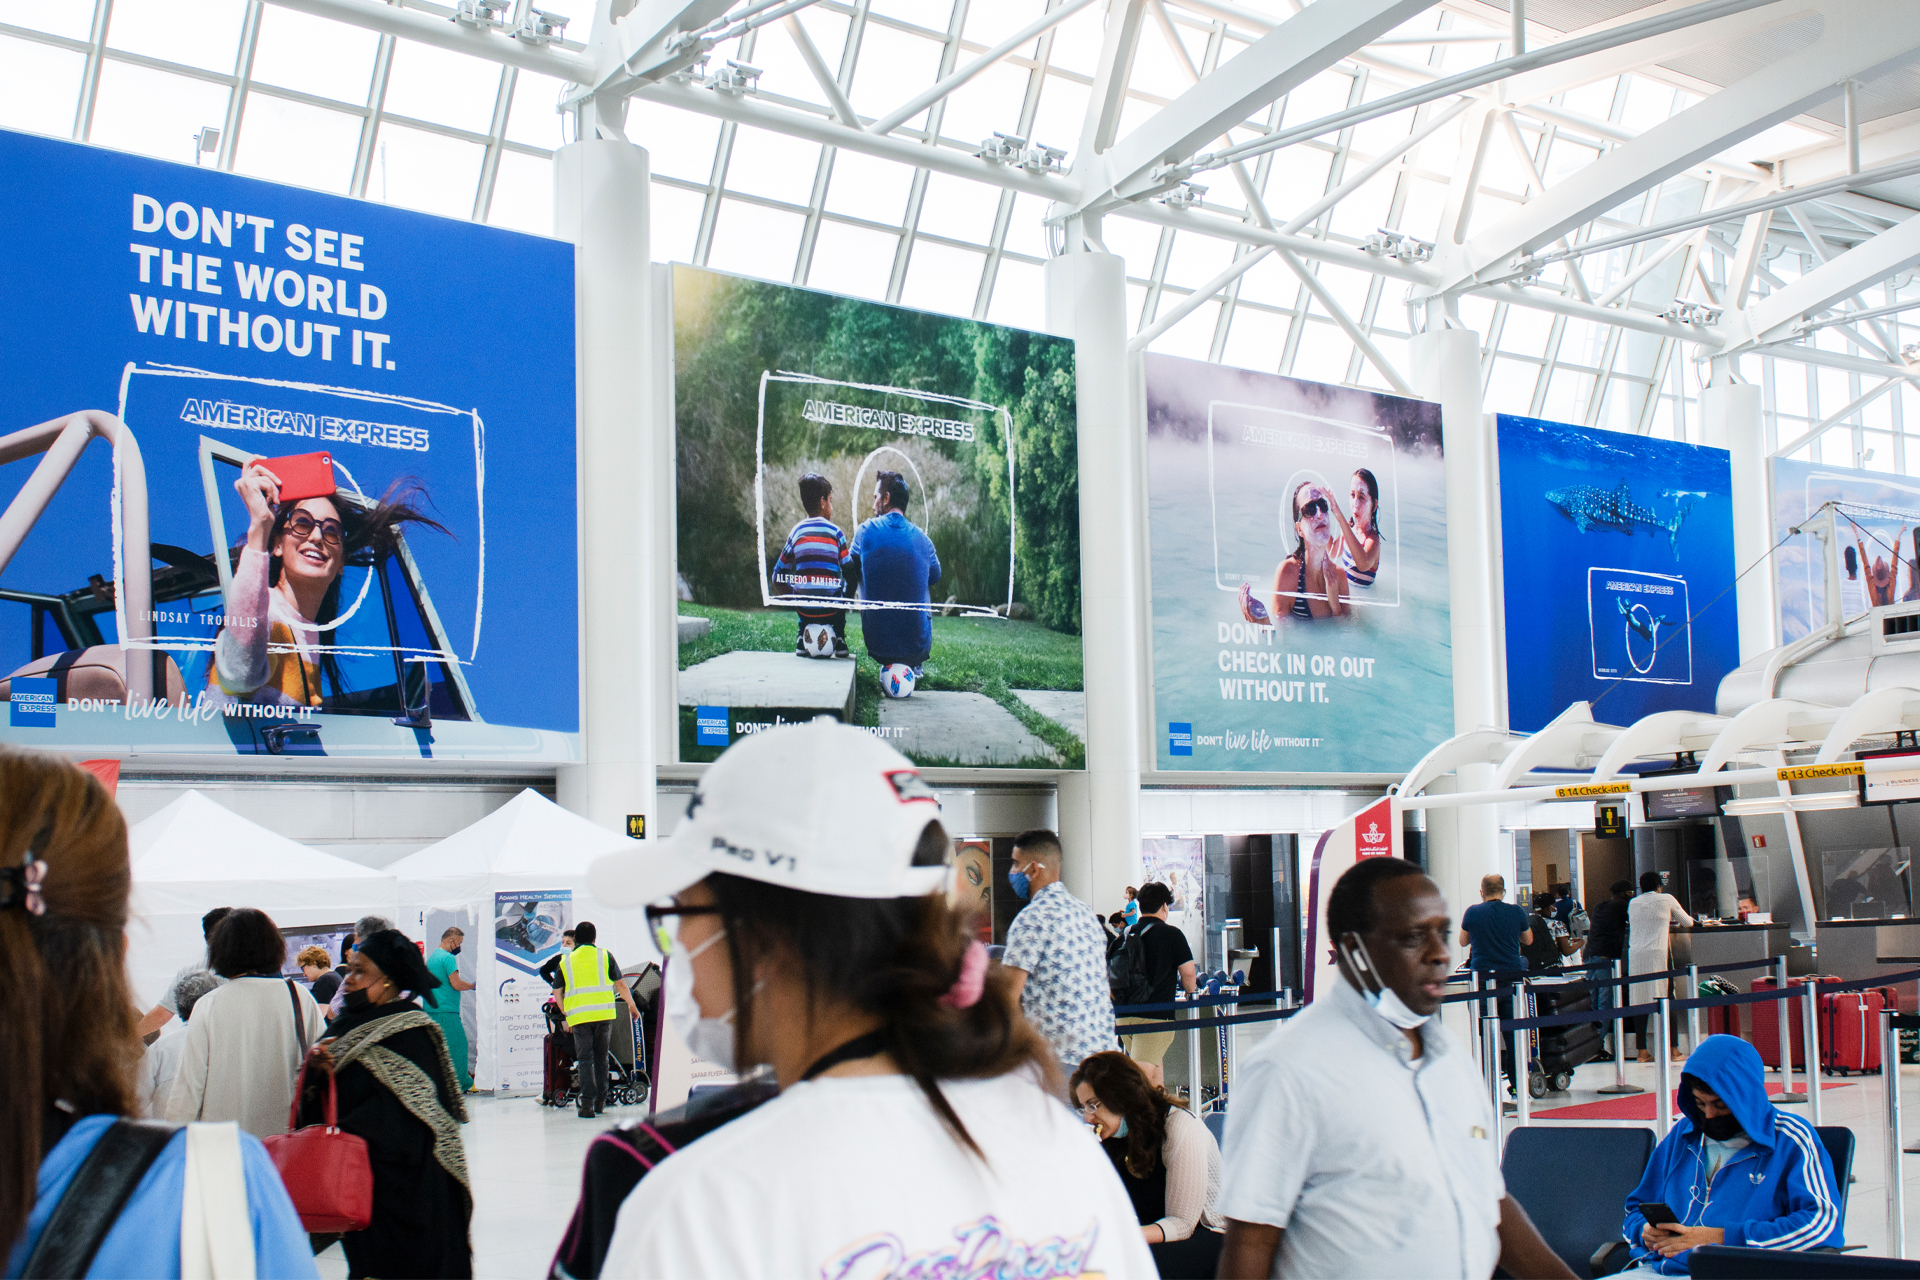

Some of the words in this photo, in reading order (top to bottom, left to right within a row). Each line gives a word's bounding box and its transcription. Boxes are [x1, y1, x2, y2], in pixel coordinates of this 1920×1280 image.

[133, 194, 274, 253] DON’T
[285, 224, 364, 271] SEE
[130, 243, 222, 295] THE
[234, 261, 387, 320] WORLD
[130, 293, 340, 361] WITHOUT
[352, 330, 396, 370] IT.
[180, 398, 316, 438] AMERICAN
[320, 416, 429, 452] EXPRESS
[802, 399, 896, 431] AMERICAN
[898, 413, 975, 442] EXPRESS
[1242, 424, 1310, 450] AMERICAN
[1312, 435, 1368, 458] EXPRESS
[776, 574, 808, 584] ALFREDO
[811, 576, 842, 588] RAMIREZ
[1606, 580, 1642, 592] AMERICAN
[1643, 584, 1674, 595] EXPRESS
[140, 610, 190, 624] LINDSAY
[200, 614, 258, 628] TROHALIS
[1218, 622, 1274, 646] DON'T
[1218, 650, 1282, 674] CHECK
[1287, 654, 1306, 675] IN
[1311, 655, 1336, 676] OR
[1340, 657, 1375, 678] OUT
[10, 693, 54, 703] AMERICAN
[1219, 678, 1305, 702] WITHOUT
[1310, 682, 1329, 703] IT.
[19, 704, 56, 713] EXPRESS
[125, 688, 176, 721] live
[177, 690, 220, 726] life
[224, 703, 294, 719] WITHOUT
[1197, 735, 1223, 746] DON'T
[1225, 729, 1249, 750] live
[1251, 729, 1273, 753] life
[1274, 737, 1310, 747] WITHOUT
[1781, 771, 1788, 779] B
[1791, 770, 1803, 779] 13
[1806, 766, 1851, 778] Check-in
[1558, 788, 1565, 797] B
[1568, 787, 1578, 796] 14
[1580, 785, 1620, 795] Check-in
[765, 850, 796, 872] V1
